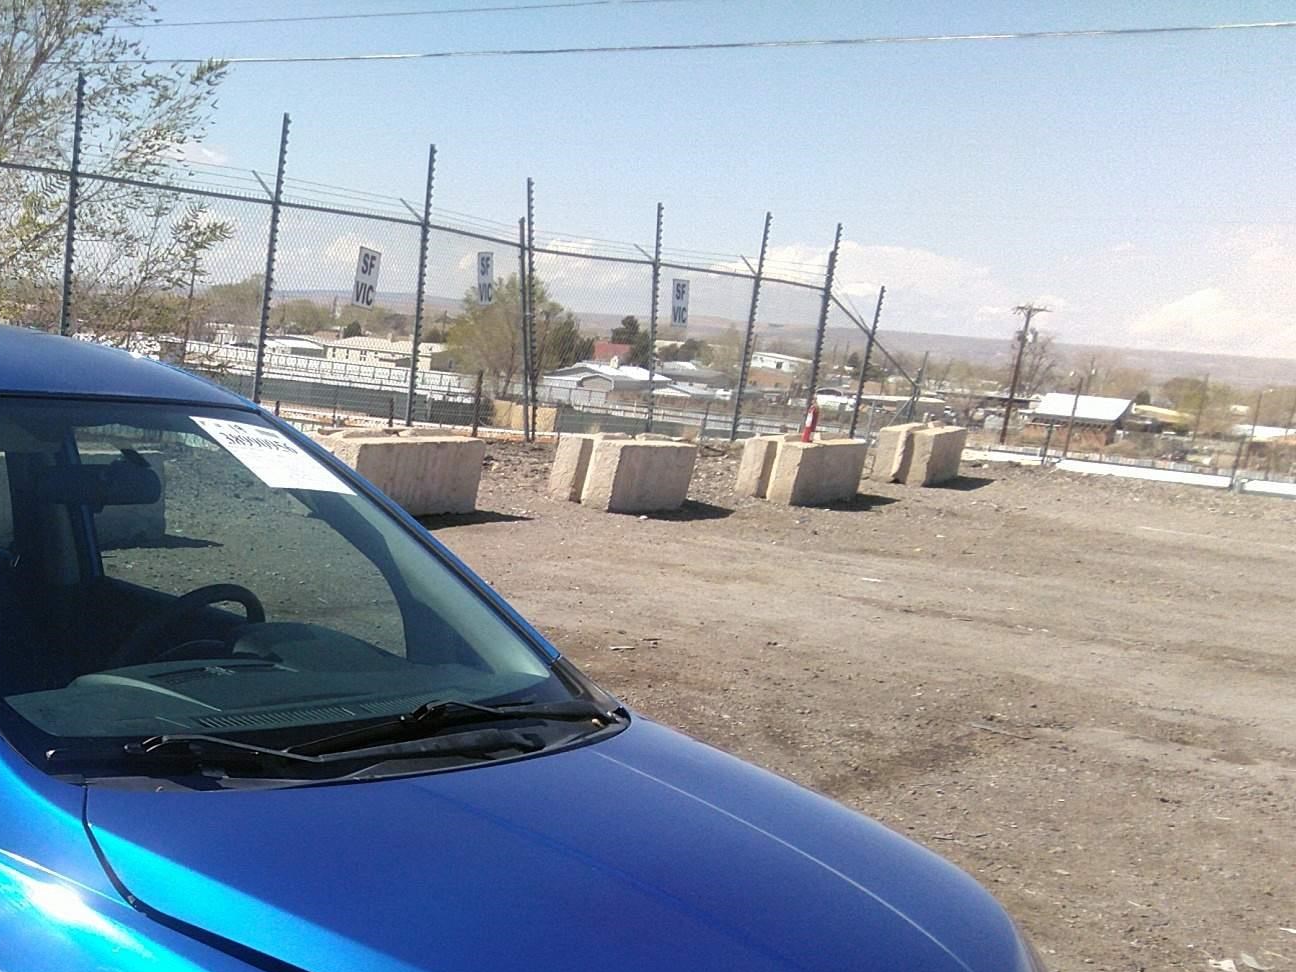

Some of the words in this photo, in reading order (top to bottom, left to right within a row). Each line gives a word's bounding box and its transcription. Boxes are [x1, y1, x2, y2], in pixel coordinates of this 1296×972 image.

[361, 253, 377, 277] SF
[480, 256, 491, 276] SF
[356, 280, 375, 306] VIC
[478, 283, 493, 302] VIC
[675, 282, 687, 300] SF
[673, 306, 688, 323] VIC
